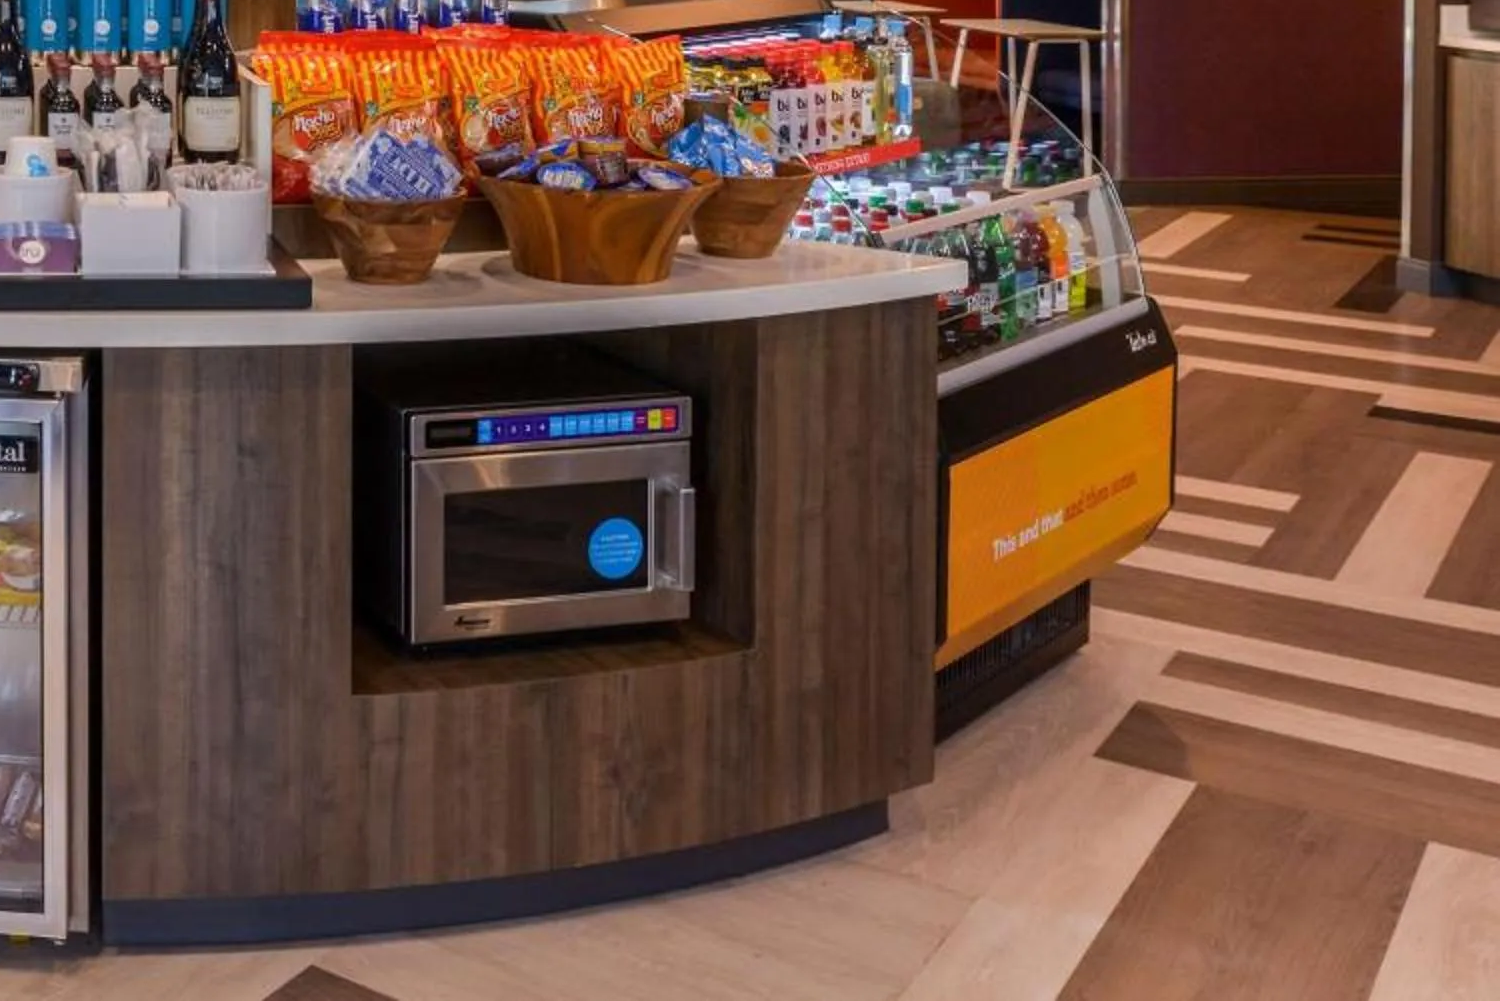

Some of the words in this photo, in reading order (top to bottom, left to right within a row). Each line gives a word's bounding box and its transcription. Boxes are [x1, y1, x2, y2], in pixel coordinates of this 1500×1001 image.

[293, 107, 336, 132] Nacho
[993, 535, 1017, 562] This
[1018, 518, 1040, 546] and
[1041, 508, 1064, 534] that
